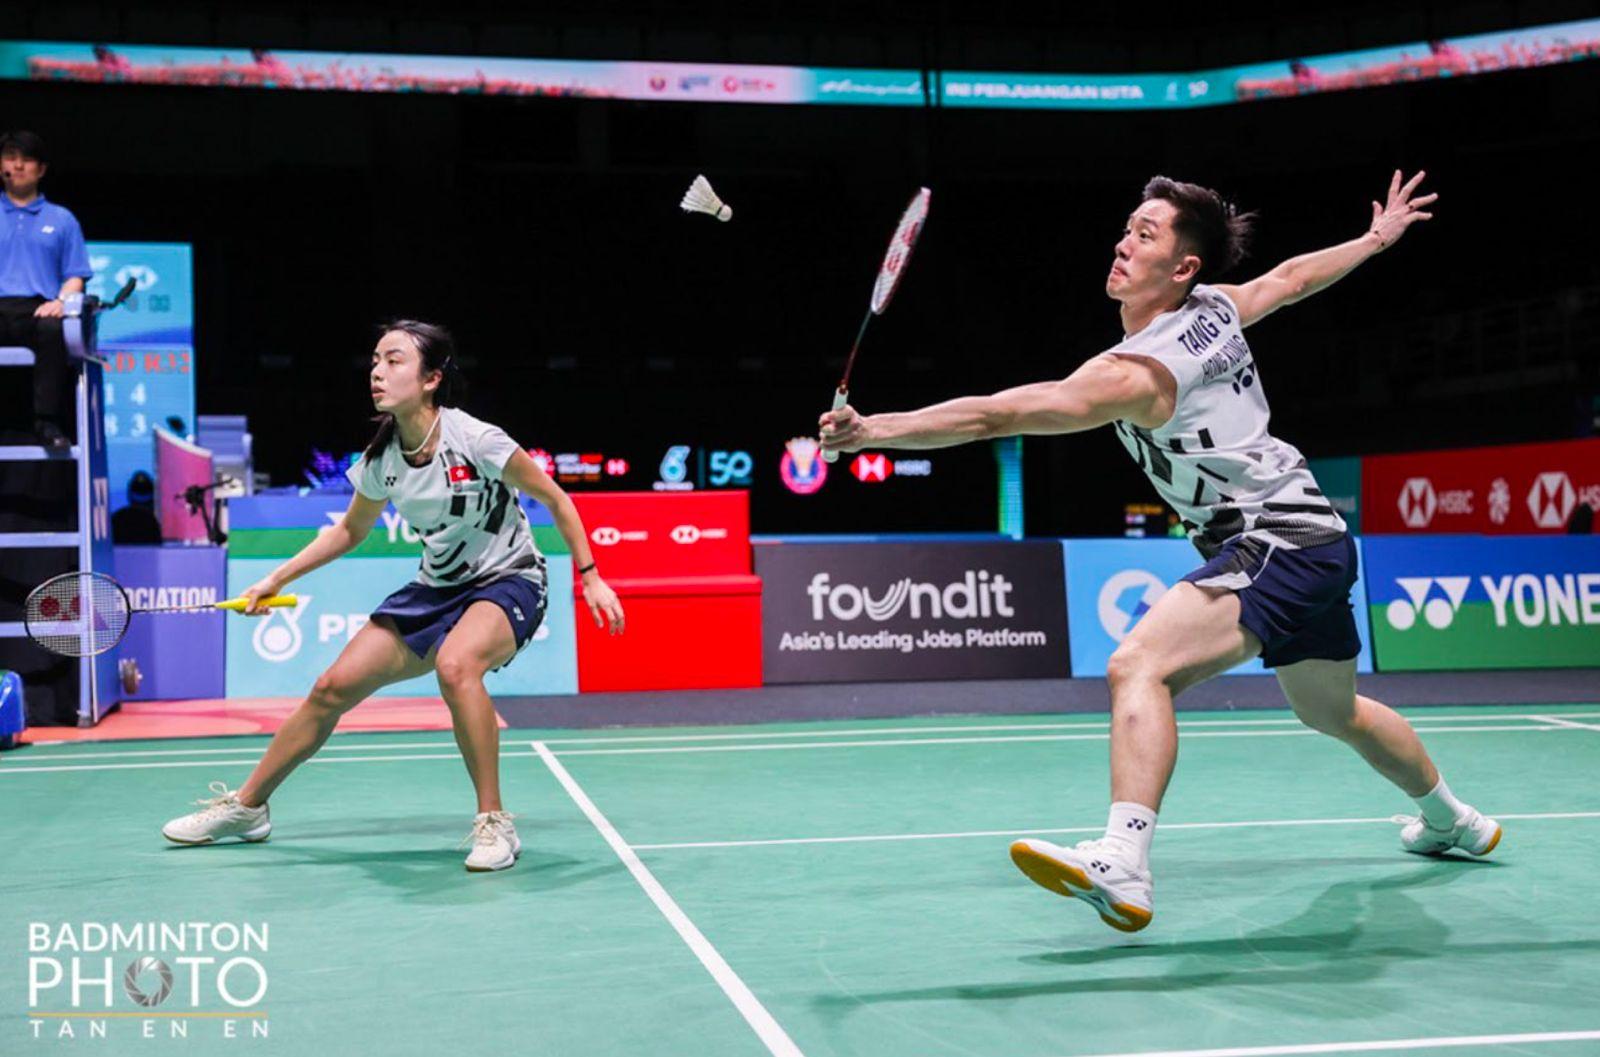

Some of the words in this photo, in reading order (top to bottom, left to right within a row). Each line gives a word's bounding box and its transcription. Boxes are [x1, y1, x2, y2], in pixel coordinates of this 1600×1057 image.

[1177, 314, 1220, 357] TANG
[130, 382, 146, 406] 4
[710, 450, 753, 485] 50
[807, 570, 1015, 621] foundit
[779, 632, 835, 651] Asia's
[837, 631, 914, 653] Leading
[916, 629, 963, 649] Jobs
[965, 628, 1047, 648] Platform
